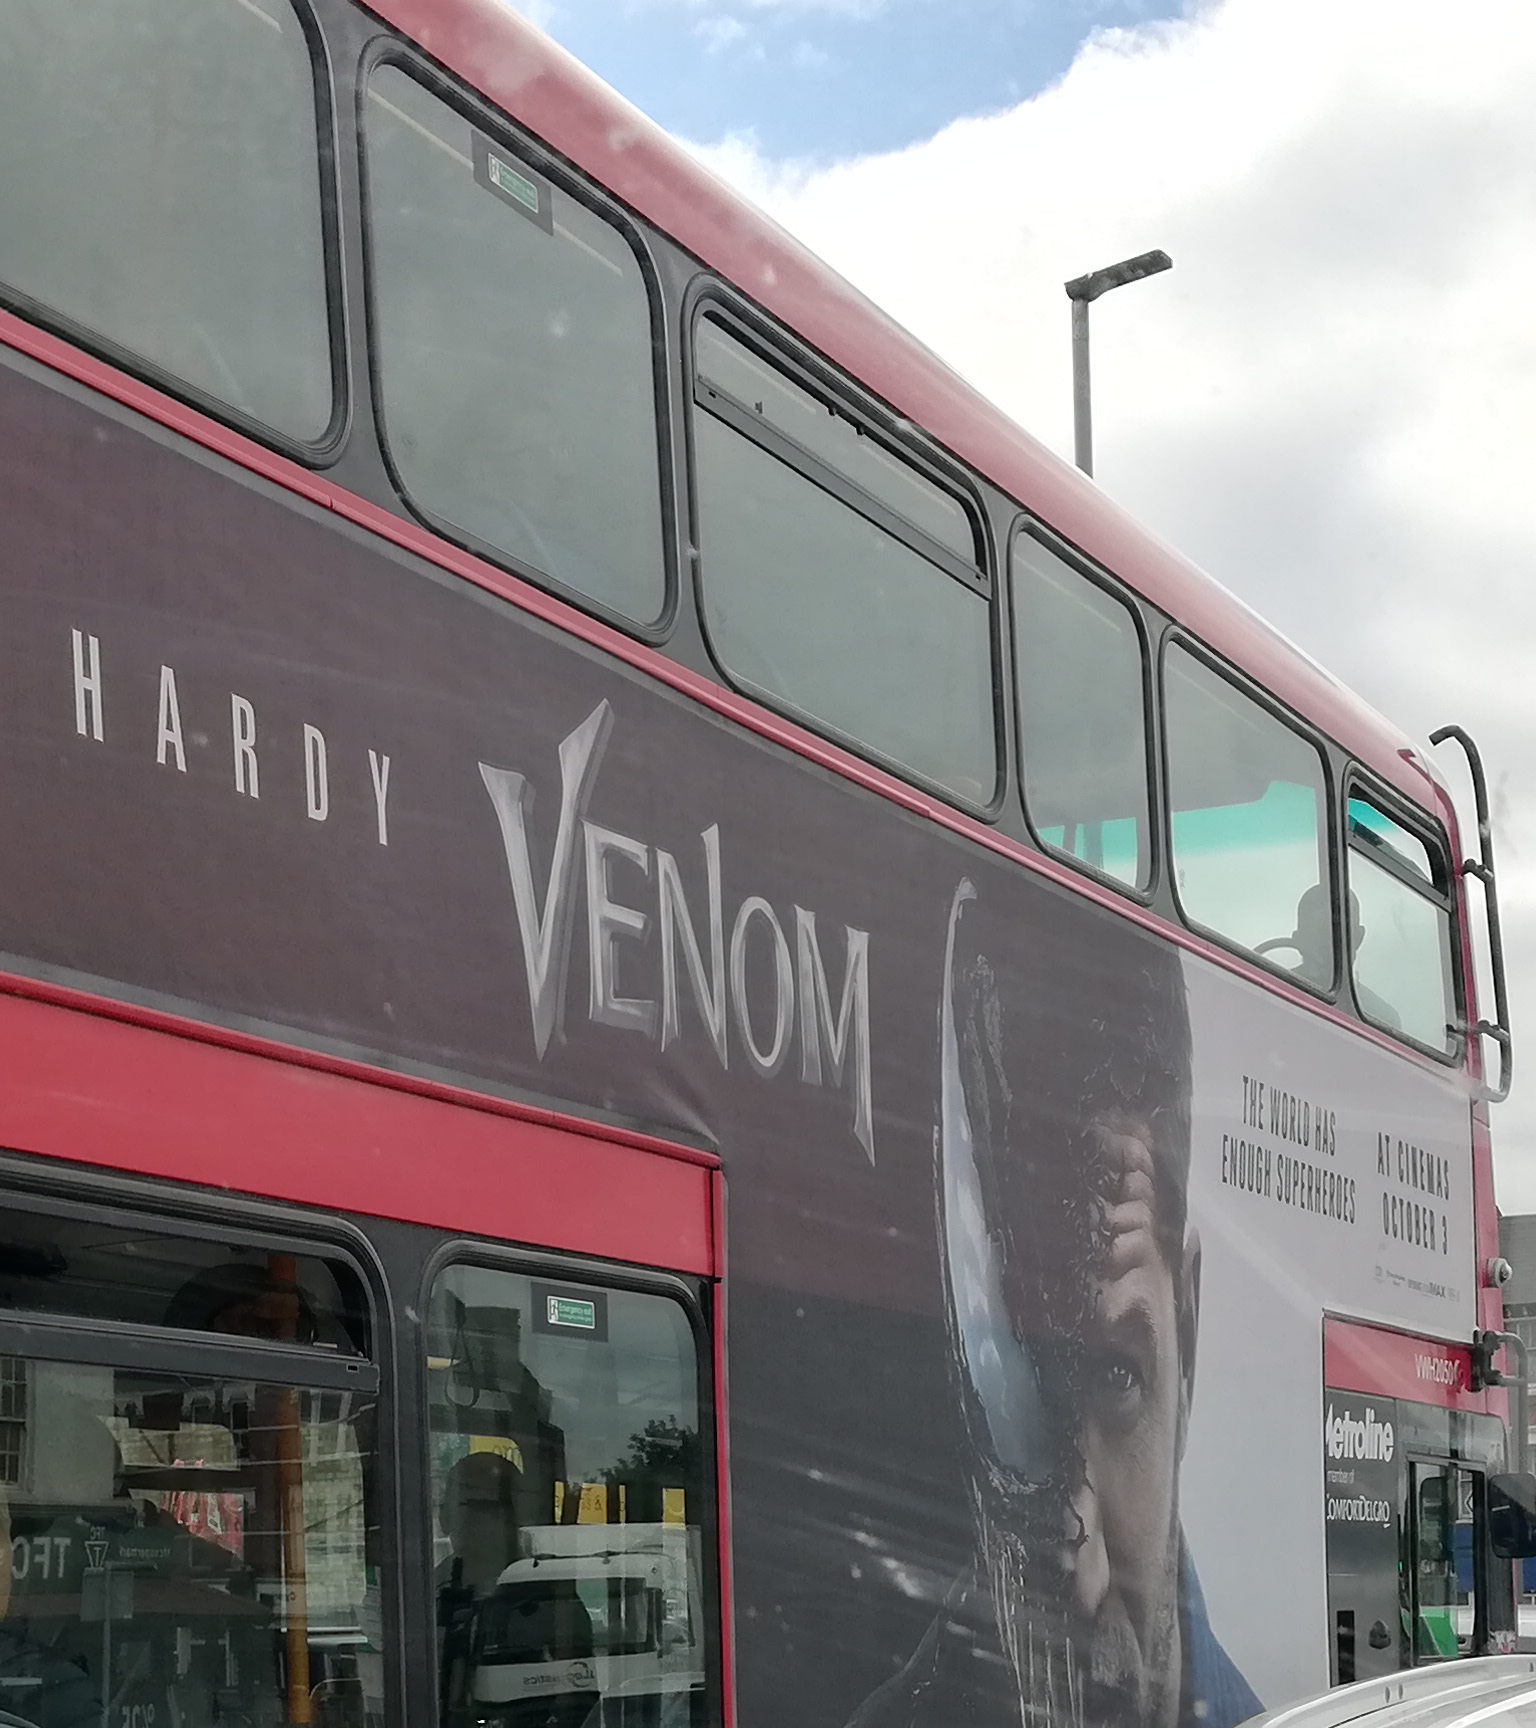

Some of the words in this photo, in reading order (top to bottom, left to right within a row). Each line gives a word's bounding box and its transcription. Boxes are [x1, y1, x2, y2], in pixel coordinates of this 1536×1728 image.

[71, 628, 391, 846] HARDY
[478, 698, 875, 1168] VENOM
[1242, 1075, 1265, 1130] THE
[1269, 1086, 1310, 1148] WORLD
[1314, 1105, 1336, 1156] HAS
[1221, 1134, 1272, 1198] ENOUGH
[1276, 1154, 1356, 1225] SUPERHEROES
[1376, 1132, 1390, 1177] AT
[1397, 1140, 1450, 1201] CINEMAS
[1382, 1192, 1436, 1251] OCTOBER
[1441, 1215, 1448, 1256] 3
